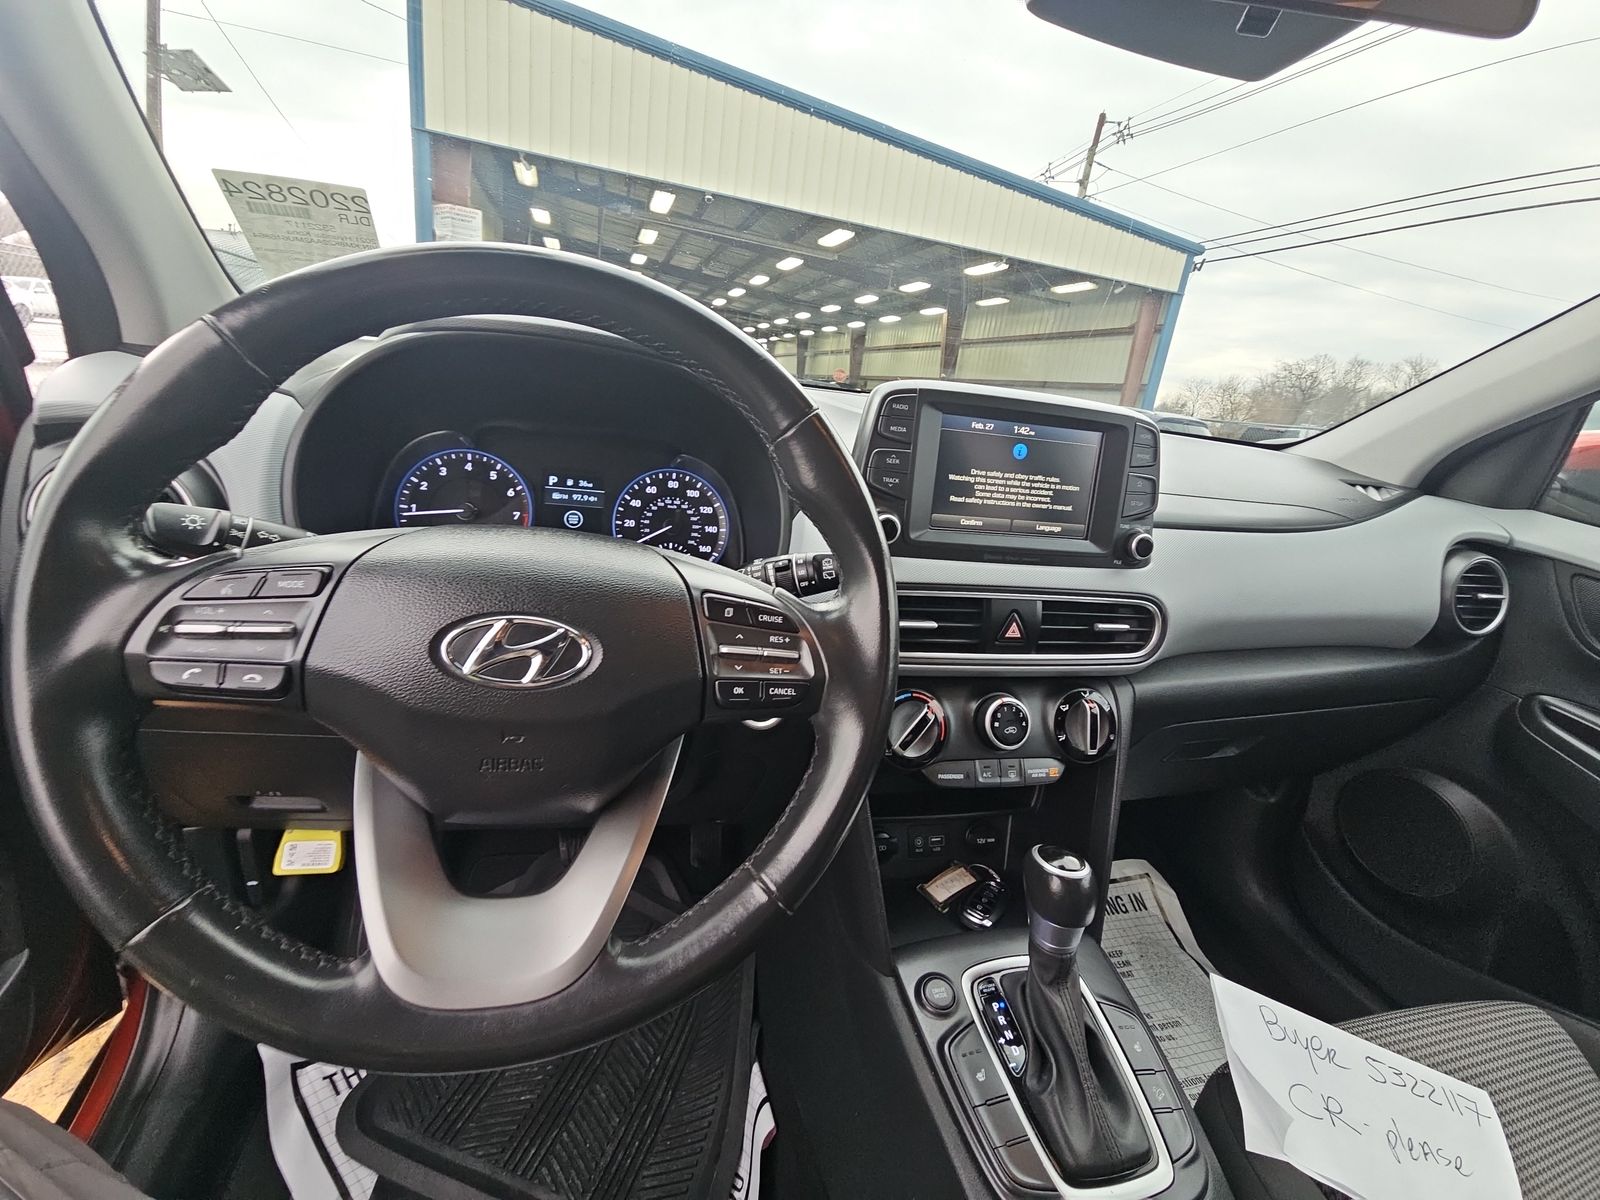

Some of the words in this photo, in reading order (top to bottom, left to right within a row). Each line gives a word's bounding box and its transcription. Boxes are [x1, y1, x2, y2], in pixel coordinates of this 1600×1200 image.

[892, 403, 909, 411] RADIO
[439, 467, 447, 476] 3
[464, 463, 472, 471] 4
[489, 471, 497, 480] 5
[971, 468, 986, 476] Drive
[1015, 473, 1028, 481] obey
[548, 475, 558, 486] P
[668, 480, 679, 489] 80
[882, 476, 900, 484] TRACK
[419, 481, 428, 490] 2
[645, 486, 657, 494] 60
[506, 488, 515, 497] 6
[686, 489, 700, 498] 100
[630, 499, 642, 507] 40
[410, 504, 417, 512] 1
[699, 506, 713, 514] 120
[513, 512, 521, 520] 7
[623, 519, 635, 527] 20
[960, 518, 983, 526] Confirm
[1036, 524, 1062, 533] Language
[704, 525, 718, 533] 140
[698, 545, 712, 553] 160
[758, 614, 784, 624] CRUISE
[733, 687, 744, 695] OK
[769, 687, 797, 696] CANCEL
[1128, 892, 1148, 912] IN
[992, 1002, 999, 1012] P
[997, 1015, 1007, 1025] R
[1004, 1029, 1014, 1040] N
[1010, 1045, 1020, 1056] D
[1365, 1056, 1492, 1127] 5322117
